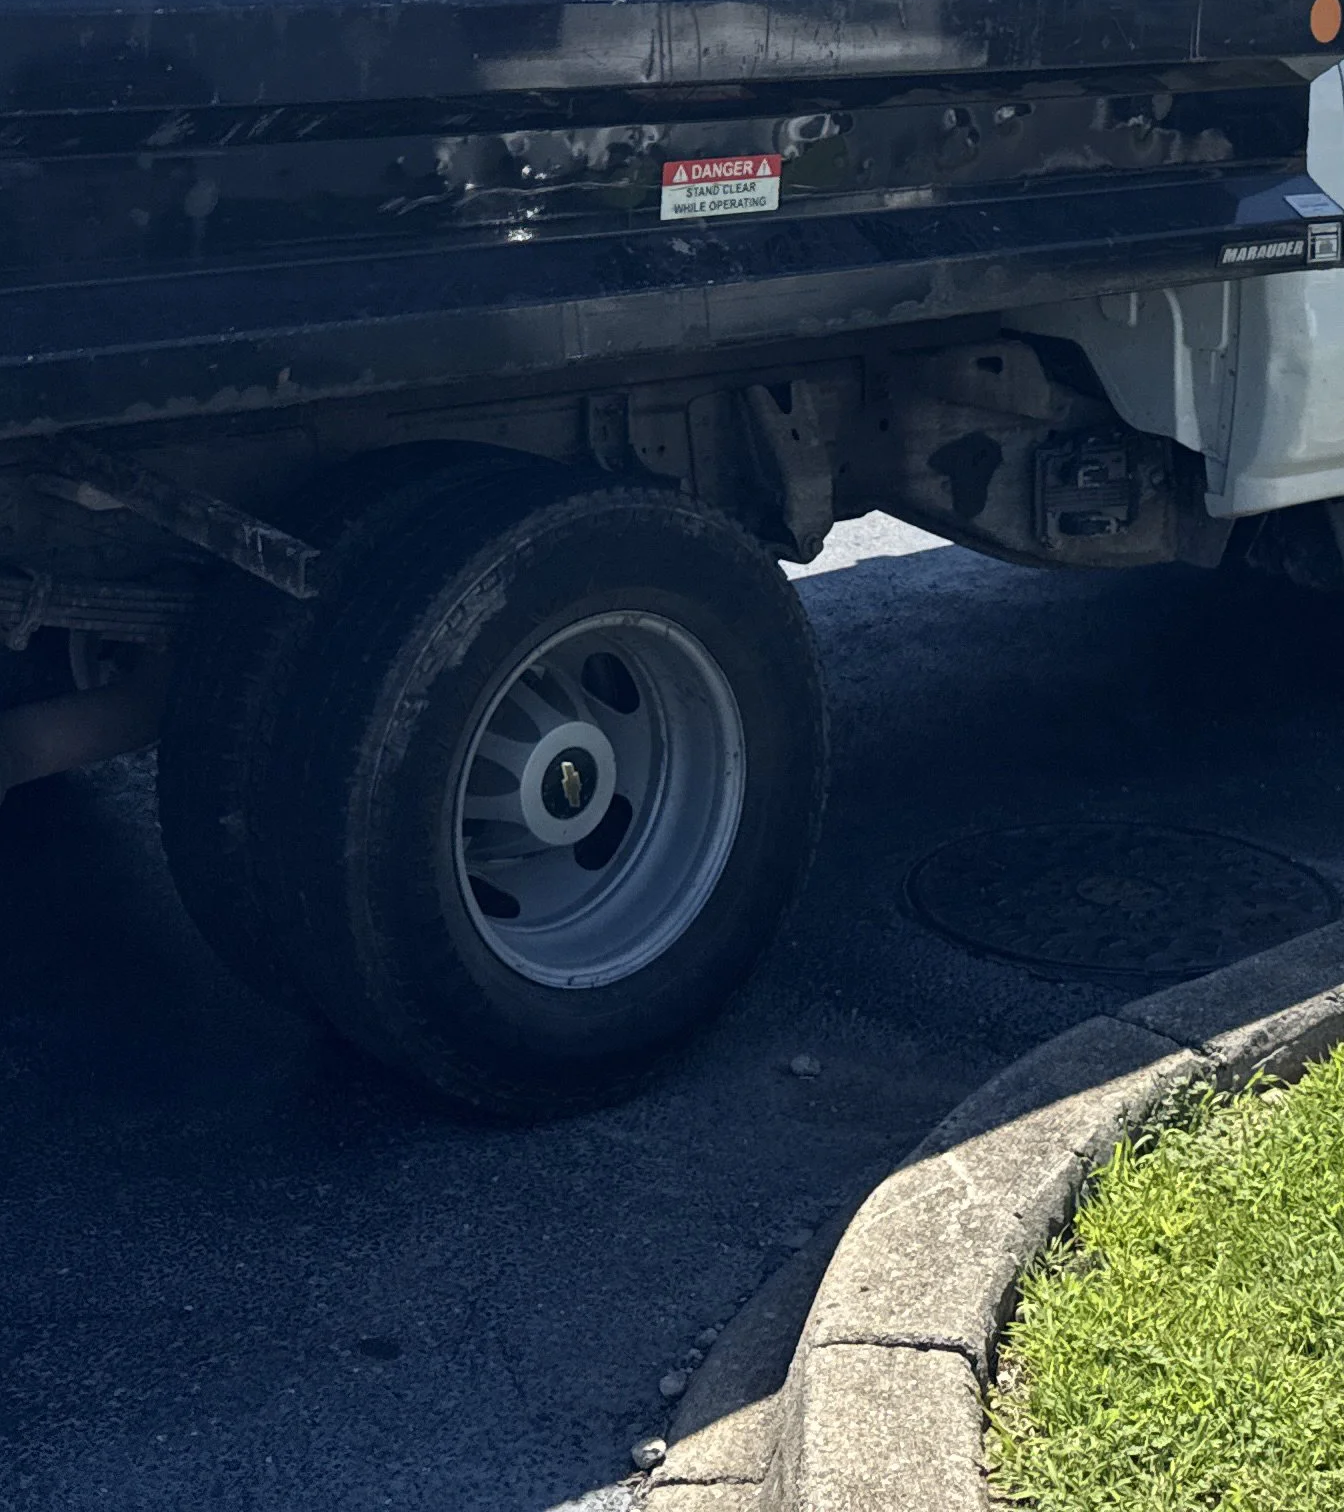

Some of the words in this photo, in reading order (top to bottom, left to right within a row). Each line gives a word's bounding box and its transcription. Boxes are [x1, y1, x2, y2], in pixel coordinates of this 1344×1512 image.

[691, 160, 754, 180] DANGER
[685, 184, 720, 198] STAND
[723, 181, 756, 194] CLEAR
[672, 200, 706, 214] WHILE
[709, 196, 767, 211] OPERATING
[1222, 240, 1305, 264] MARAUDER
